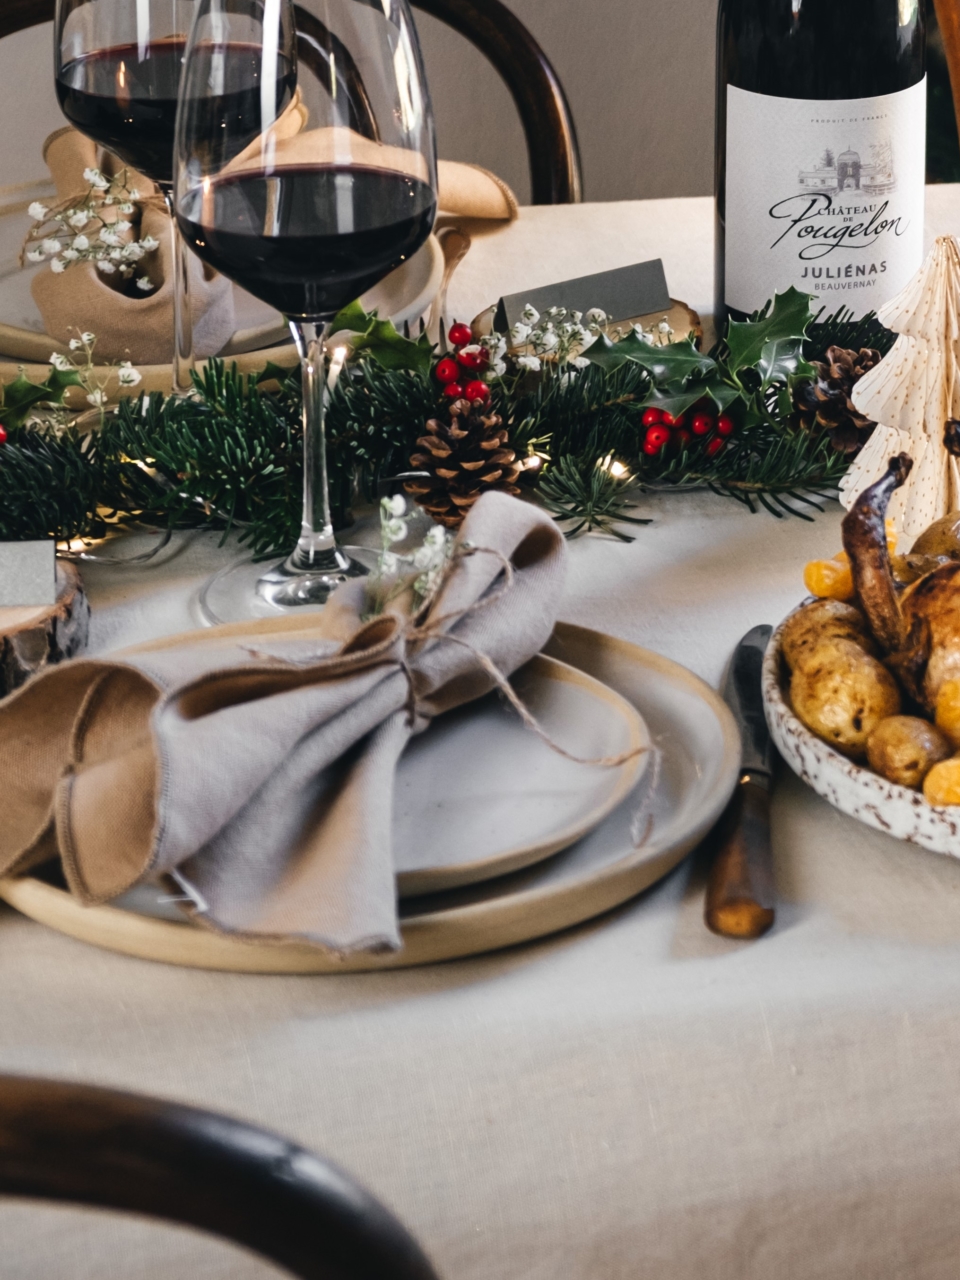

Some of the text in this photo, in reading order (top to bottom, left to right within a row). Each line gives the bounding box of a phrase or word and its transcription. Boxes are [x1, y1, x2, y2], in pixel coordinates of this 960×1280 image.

[818, 204, 877, 216] CHÂTEAU
[768, 192, 909, 260] Pougelon
[801, 260, 888, 279] JULIÉNAS
[814, 279, 877, 291] BEAUVERNAY
